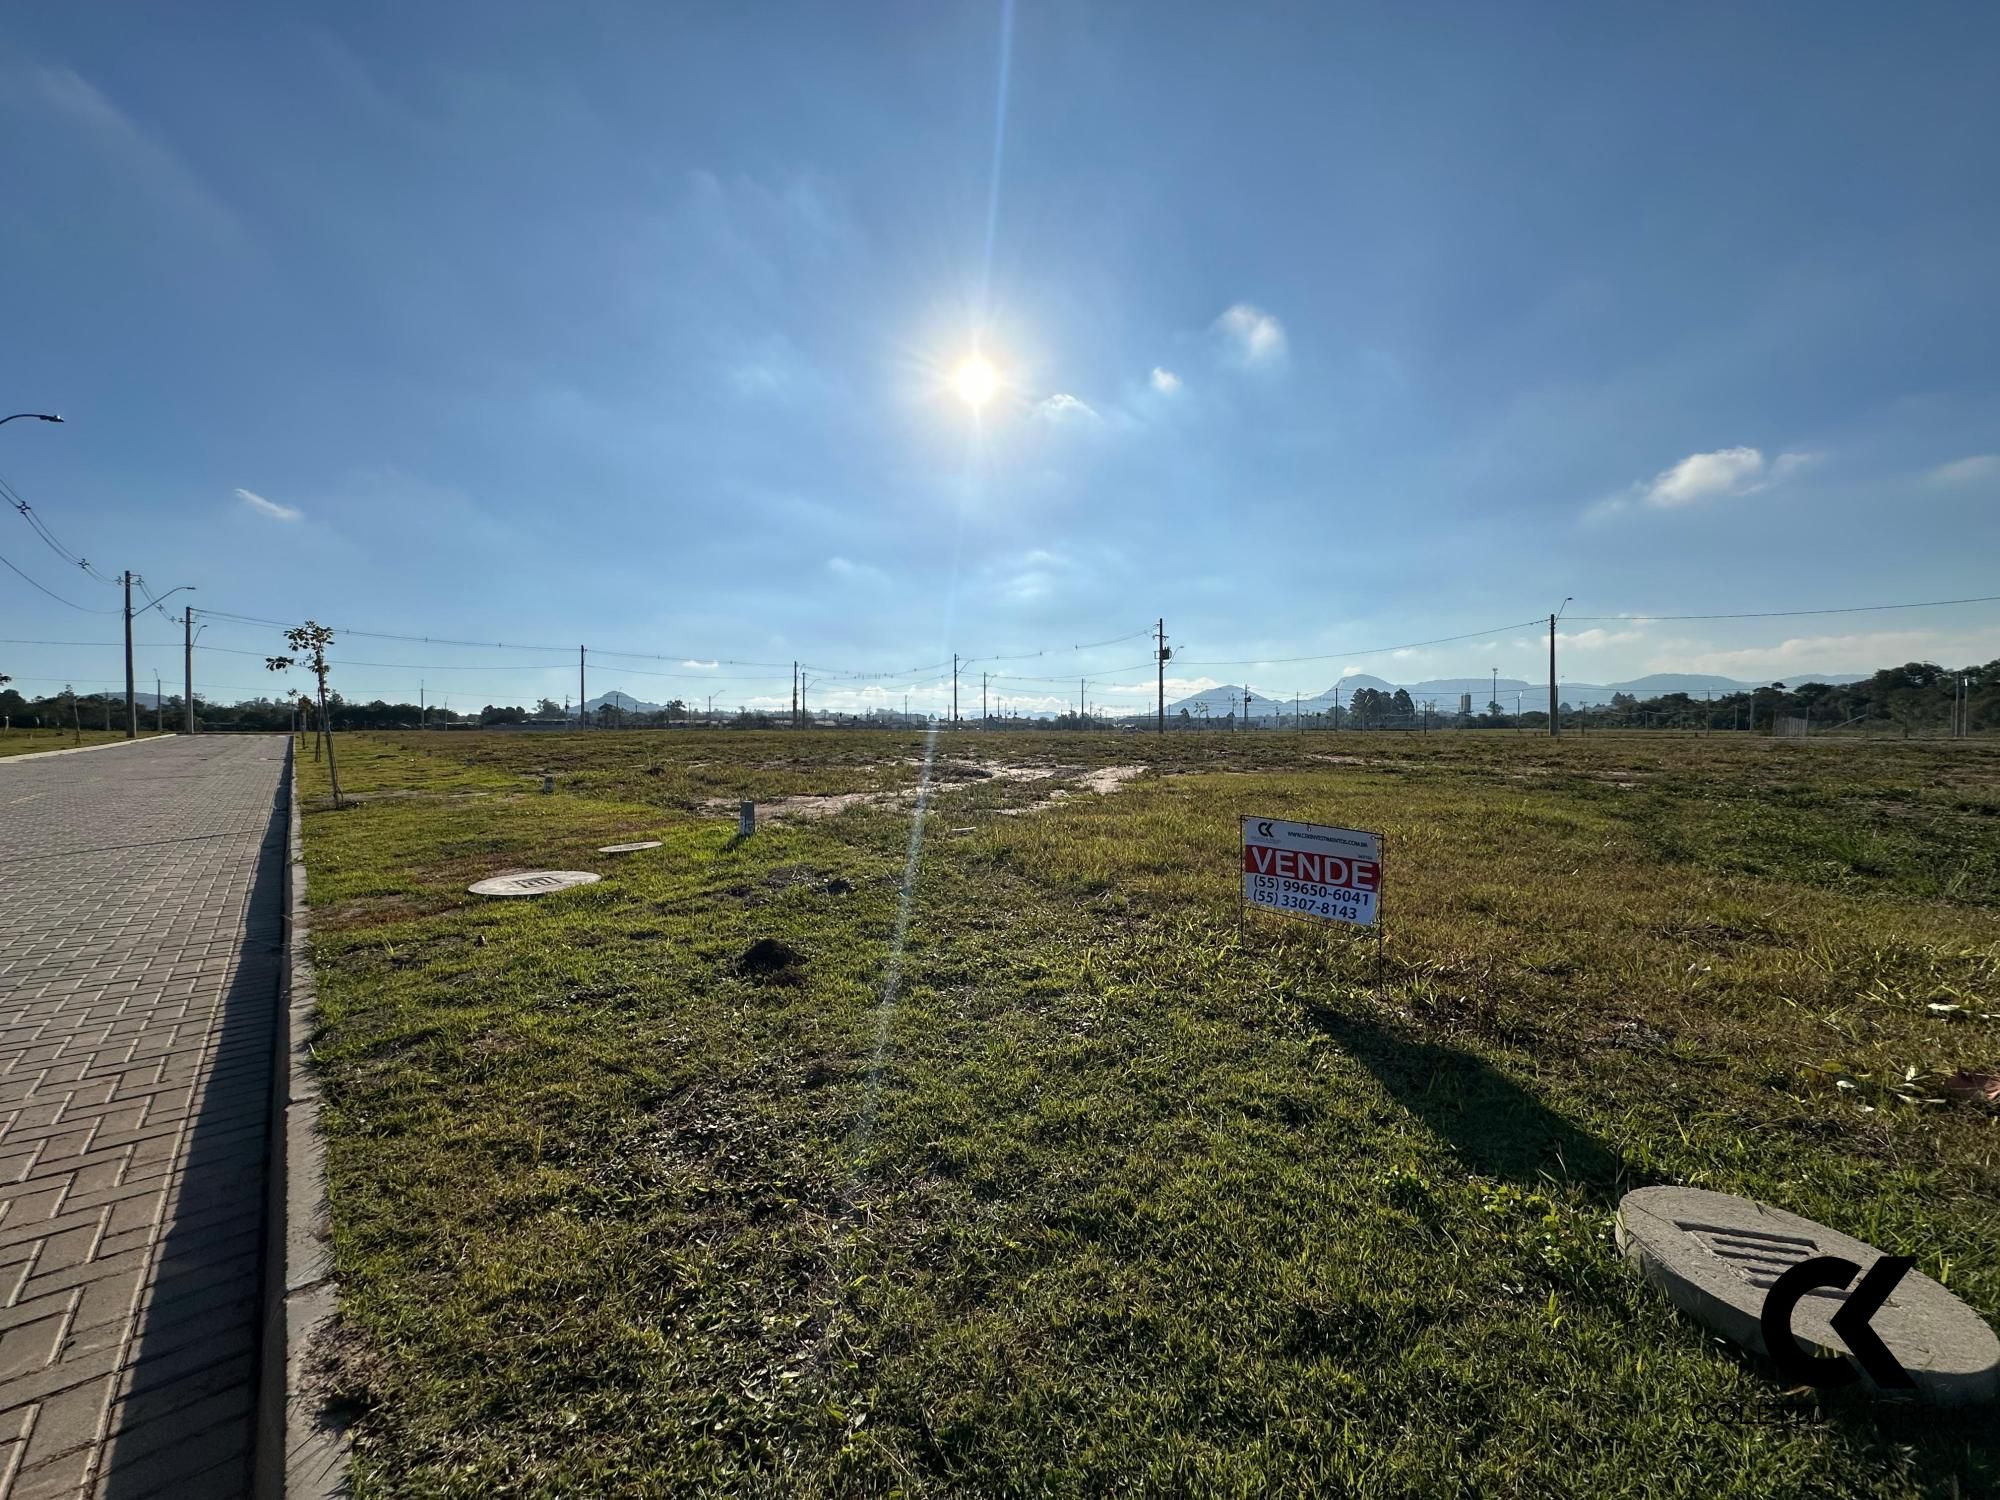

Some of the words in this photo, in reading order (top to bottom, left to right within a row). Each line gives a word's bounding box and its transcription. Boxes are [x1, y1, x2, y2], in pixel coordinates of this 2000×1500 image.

[1258, 822, 1274, 838] CK
[1252, 846, 1374, 890] VENDE
[1253, 888, 1279, 906] (55)
[1281, 894, 1357, 920] 3307-8143
[1254, 874, 1279, 891] (55)
[1283, 880, 1369, 906] 99650-6041
